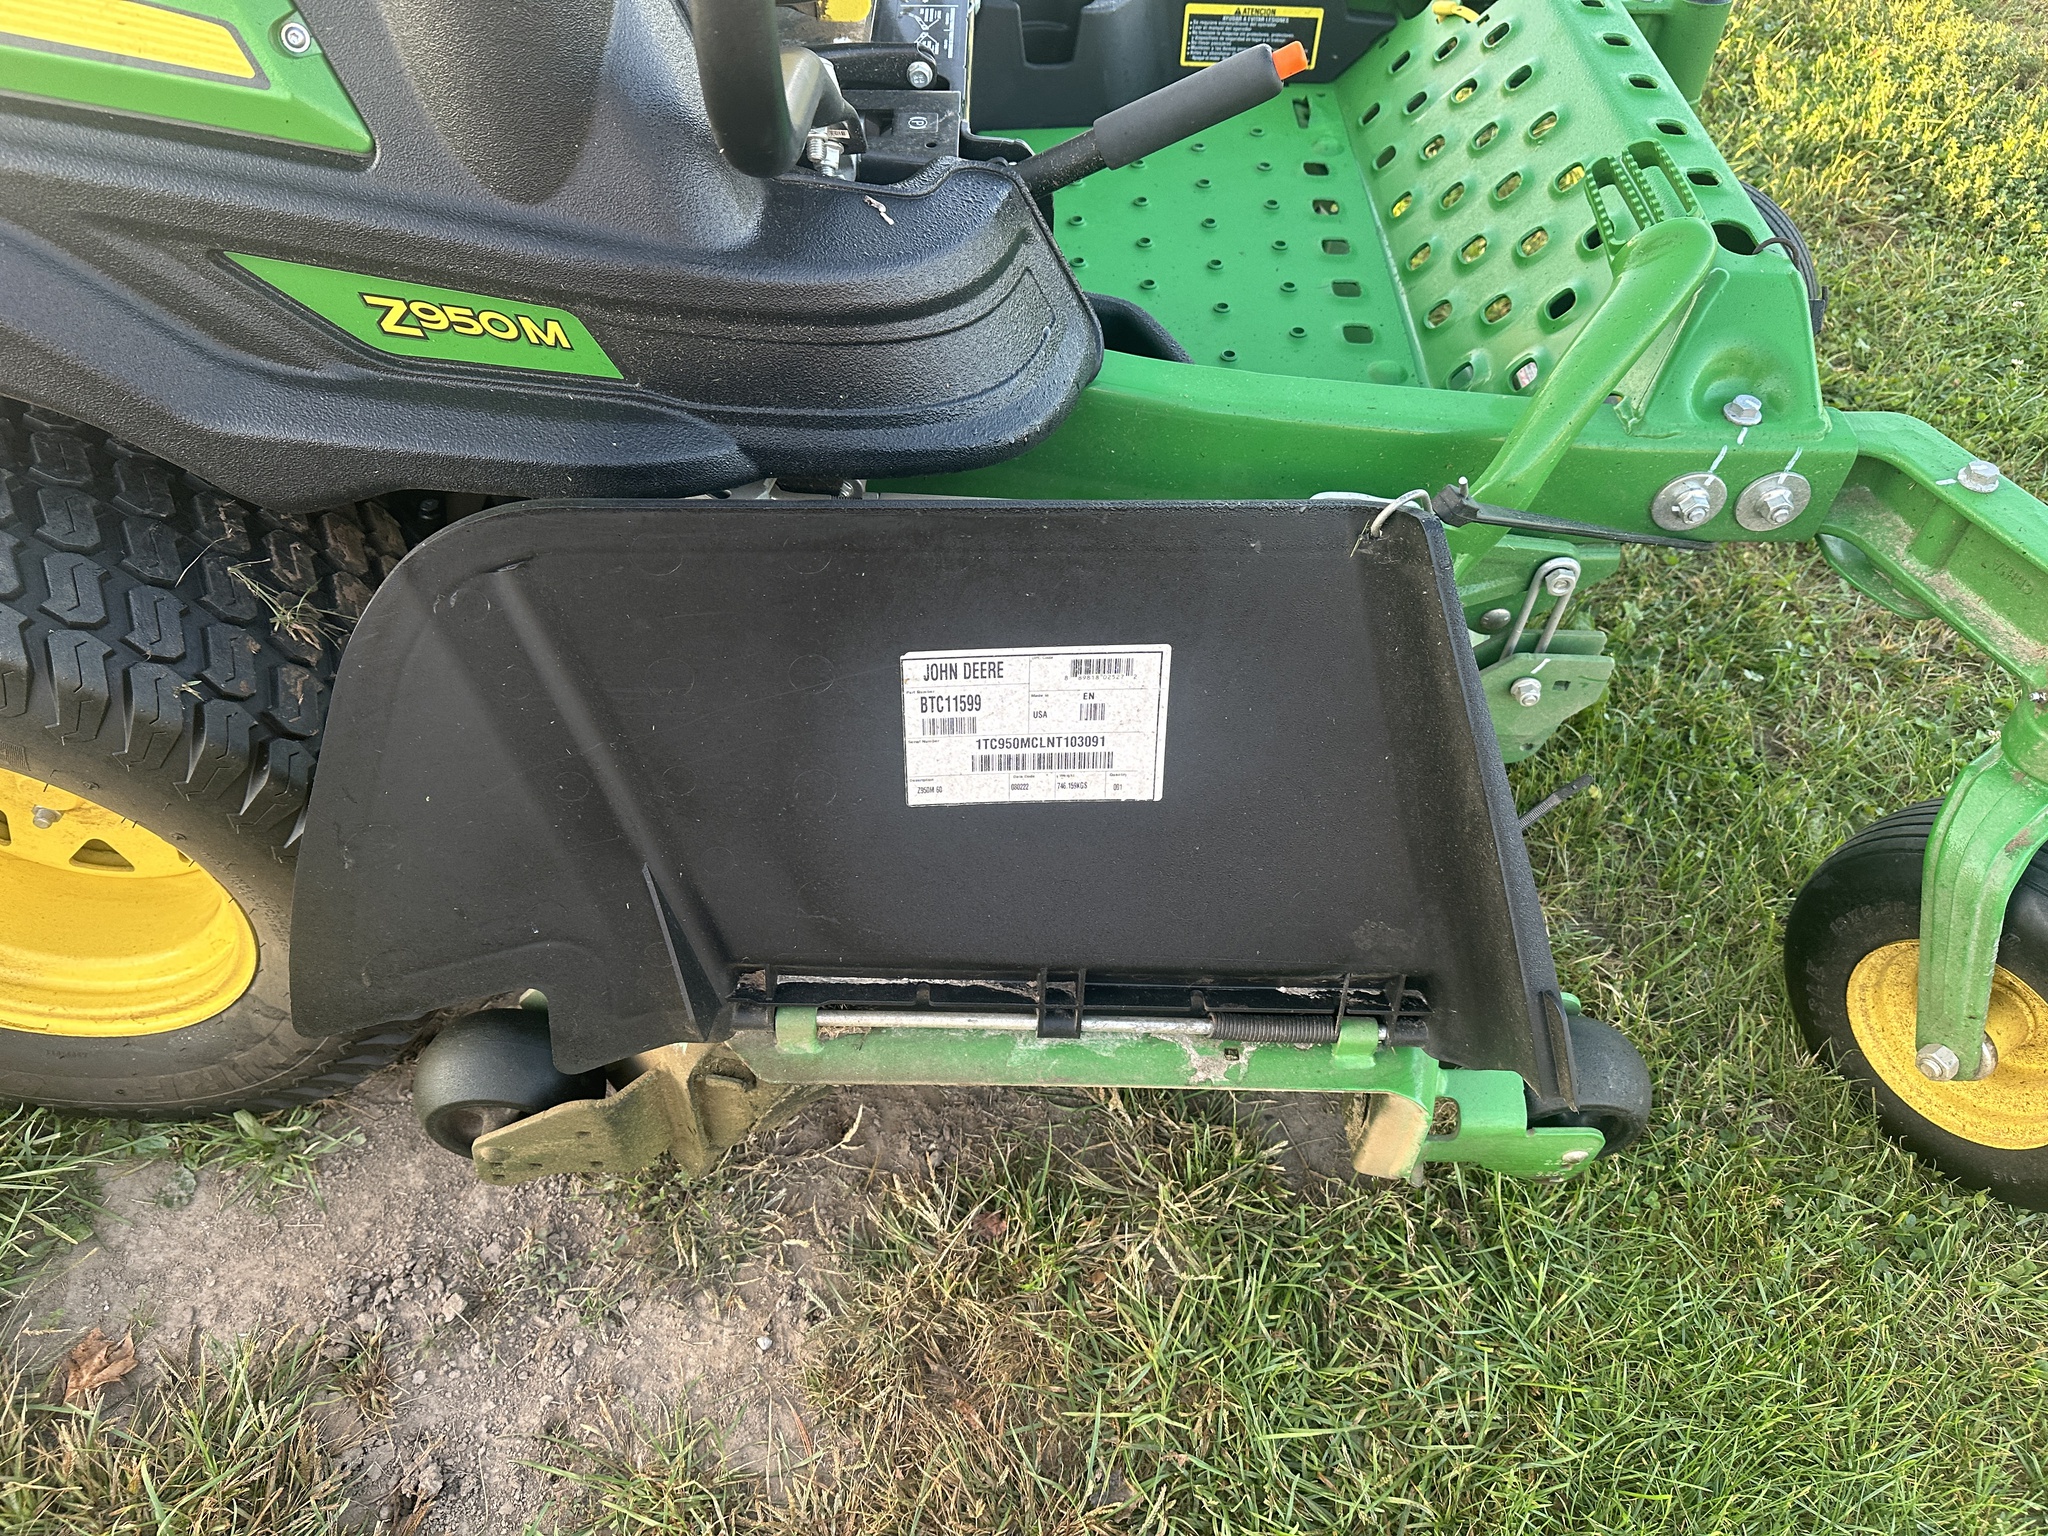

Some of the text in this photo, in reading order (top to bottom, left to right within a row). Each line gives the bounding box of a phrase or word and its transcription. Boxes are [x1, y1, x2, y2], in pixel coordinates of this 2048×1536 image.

[358, 291, 575, 351] Z950M
[923, 661, 1004, 682] JOHN DEERE
[920, 694, 982, 713] BTC11599
[1083, 692, 1095, 700] EN
[1033, 710, 1048, 719] USA
[976, 735, 1105, 750] 1TC950MCLNT103091
